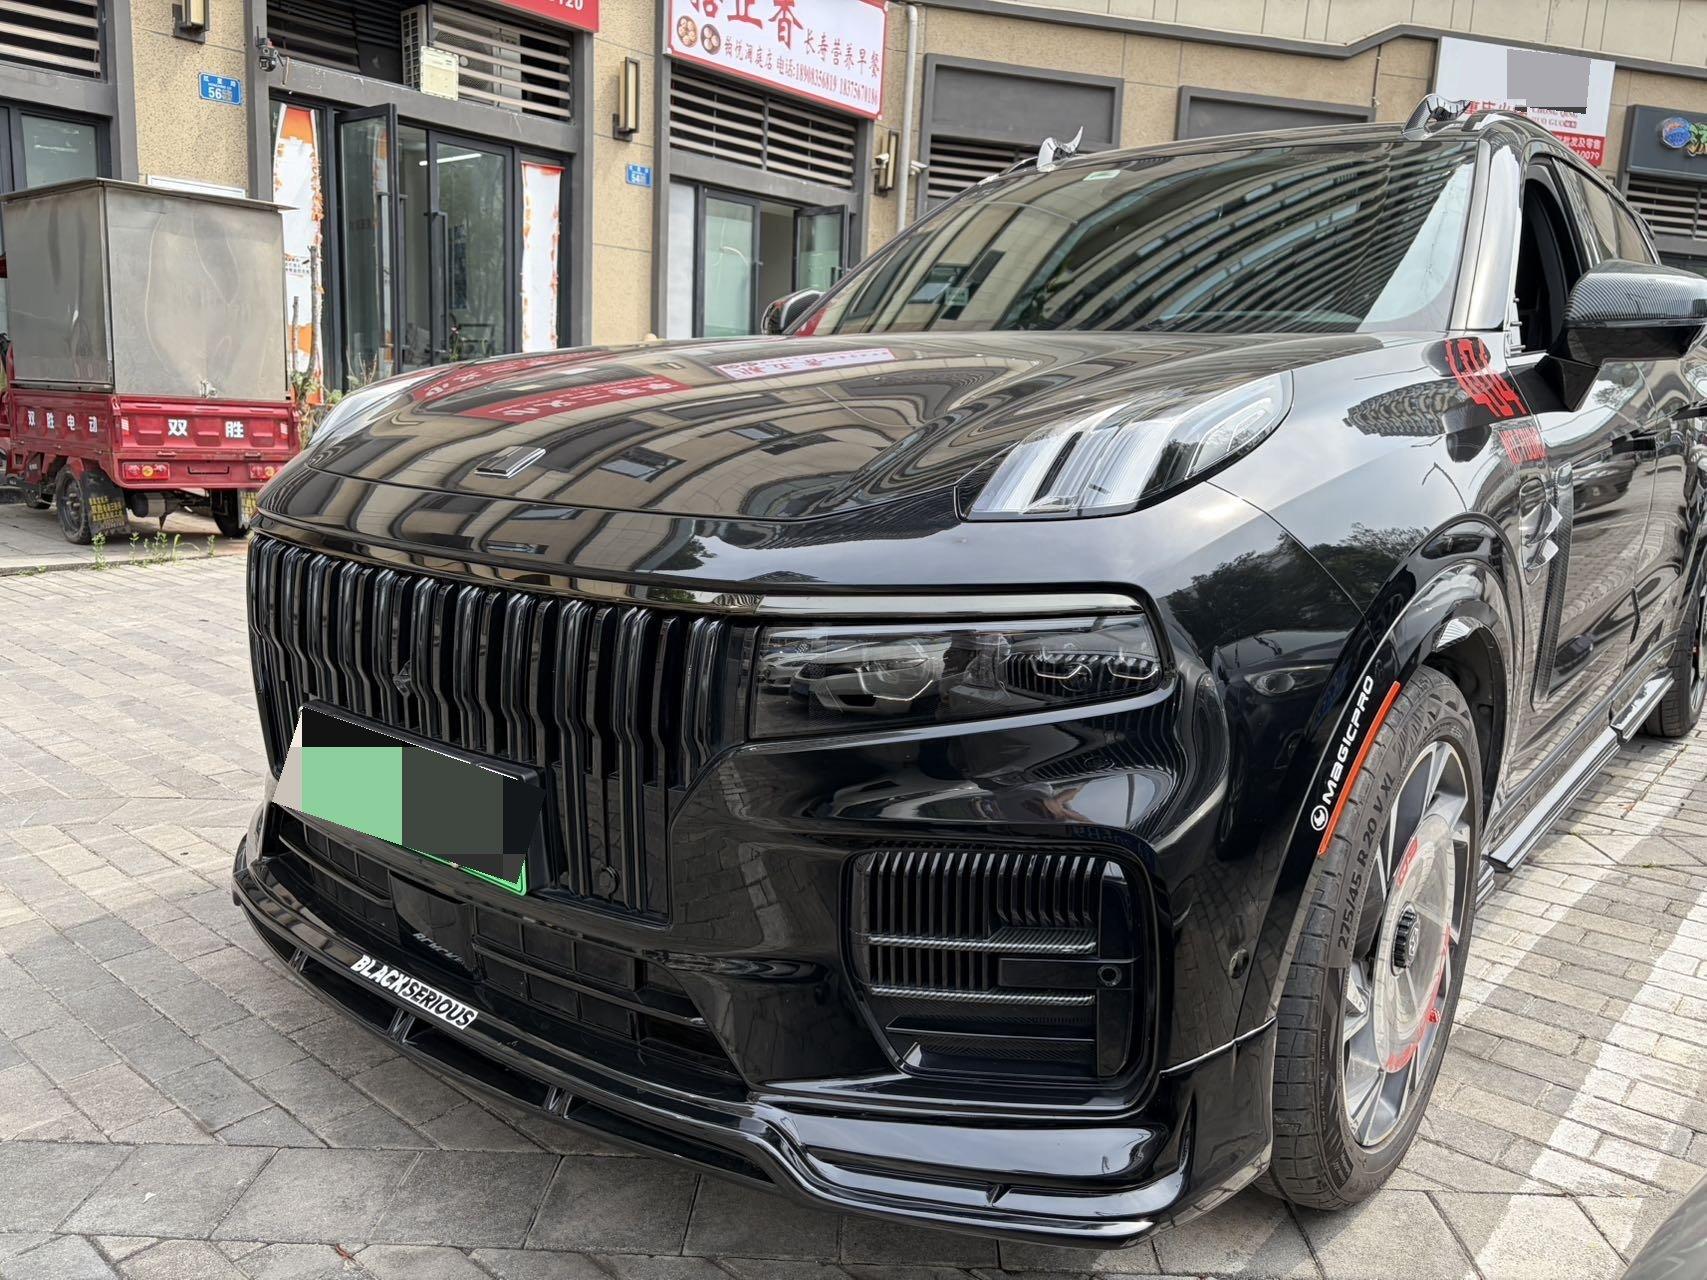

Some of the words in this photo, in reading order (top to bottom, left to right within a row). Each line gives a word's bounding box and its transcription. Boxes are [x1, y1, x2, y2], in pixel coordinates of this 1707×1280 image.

[208, 86, 222, 99] 56
[27, 410, 98, 433] 双胜电动
[168, 418, 244, 439] 双胜
[1337, 873, 1362, 950] 275/45
[1357, 850, 1369, 867] R
[1363, 818, 1378, 847] 20
[1373, 796, 1384, 814] V
[1381, 772, 1396, 792] XL
